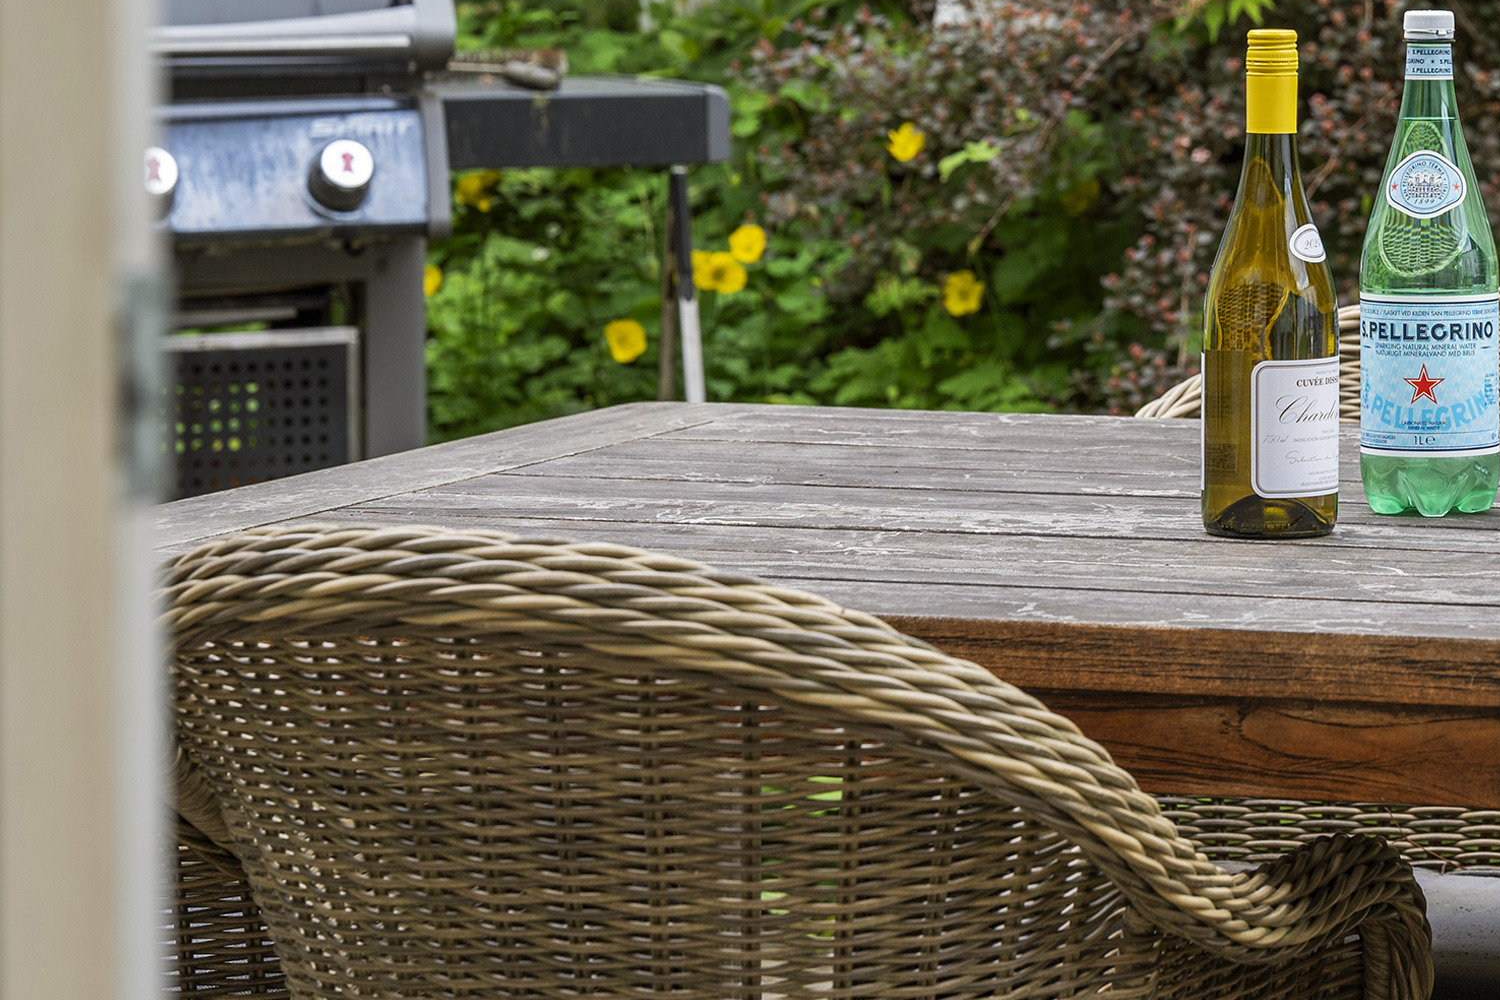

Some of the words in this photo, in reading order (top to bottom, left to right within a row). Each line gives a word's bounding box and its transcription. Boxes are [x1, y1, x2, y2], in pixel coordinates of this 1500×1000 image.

[1361, 320, 1493, 341] S.PELLEGRINO
[1402, 343, 1430, 351] NATURAL
[1431, 343, 1457, 351] MINERAL
[1296, 376, 1324, 388] CUVÉE
